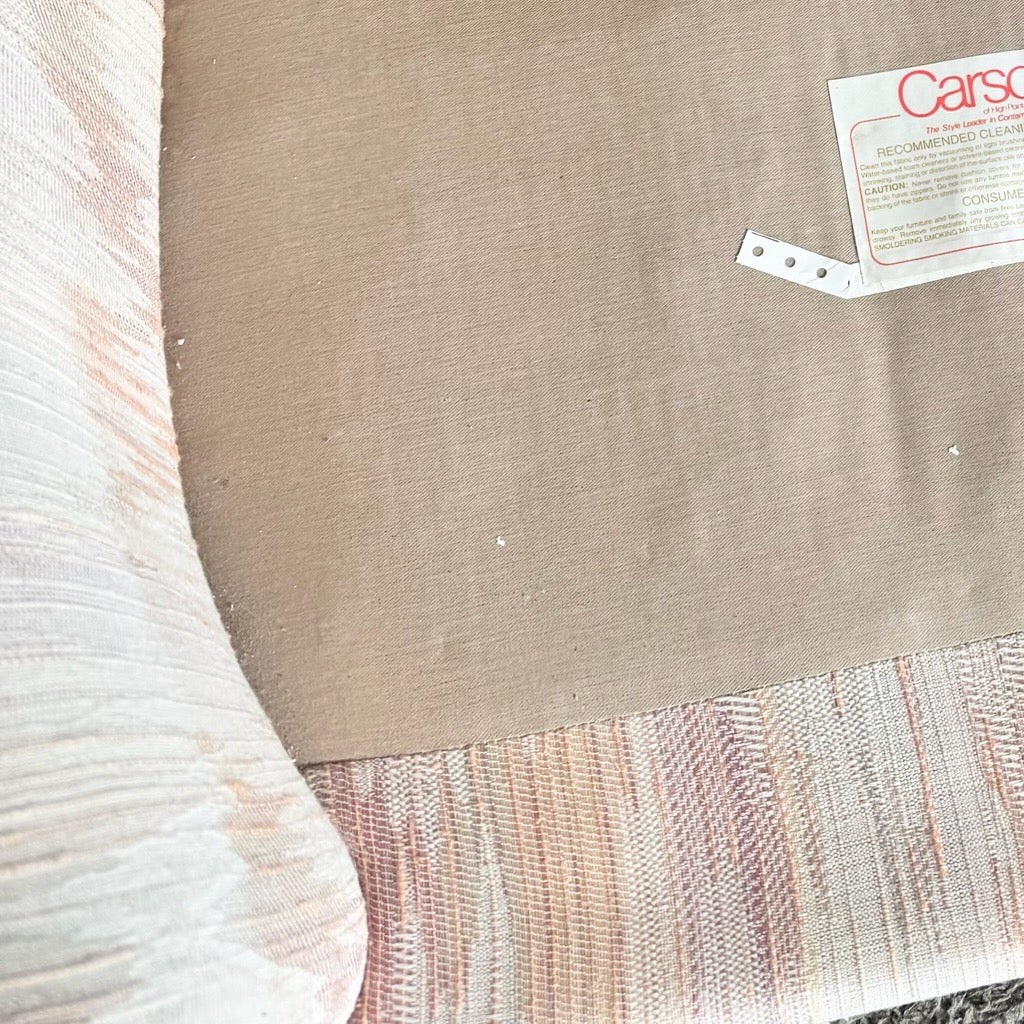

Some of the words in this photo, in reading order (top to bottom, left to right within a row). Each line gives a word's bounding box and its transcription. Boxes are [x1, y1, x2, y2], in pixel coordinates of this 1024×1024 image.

[926, 125, 940, 134] The
[941, 122, 962, 133] Style
[962, 117, 988, 128] Leader
[988, 116, 997, 124] in
[876, 131, 978, 159] RECOMMENDED
[913, 154, 927, 162] only
[864, 182, 908, 196] CAUTION:
[871, 227, 890, 237] Keep
[874, 237, 923, 251] SMOLDERING
[924, 230, 957, 242] SMOKING
[959, 222, 999, 235] MATERIALS
[900, 228, 927, 238] Remove
